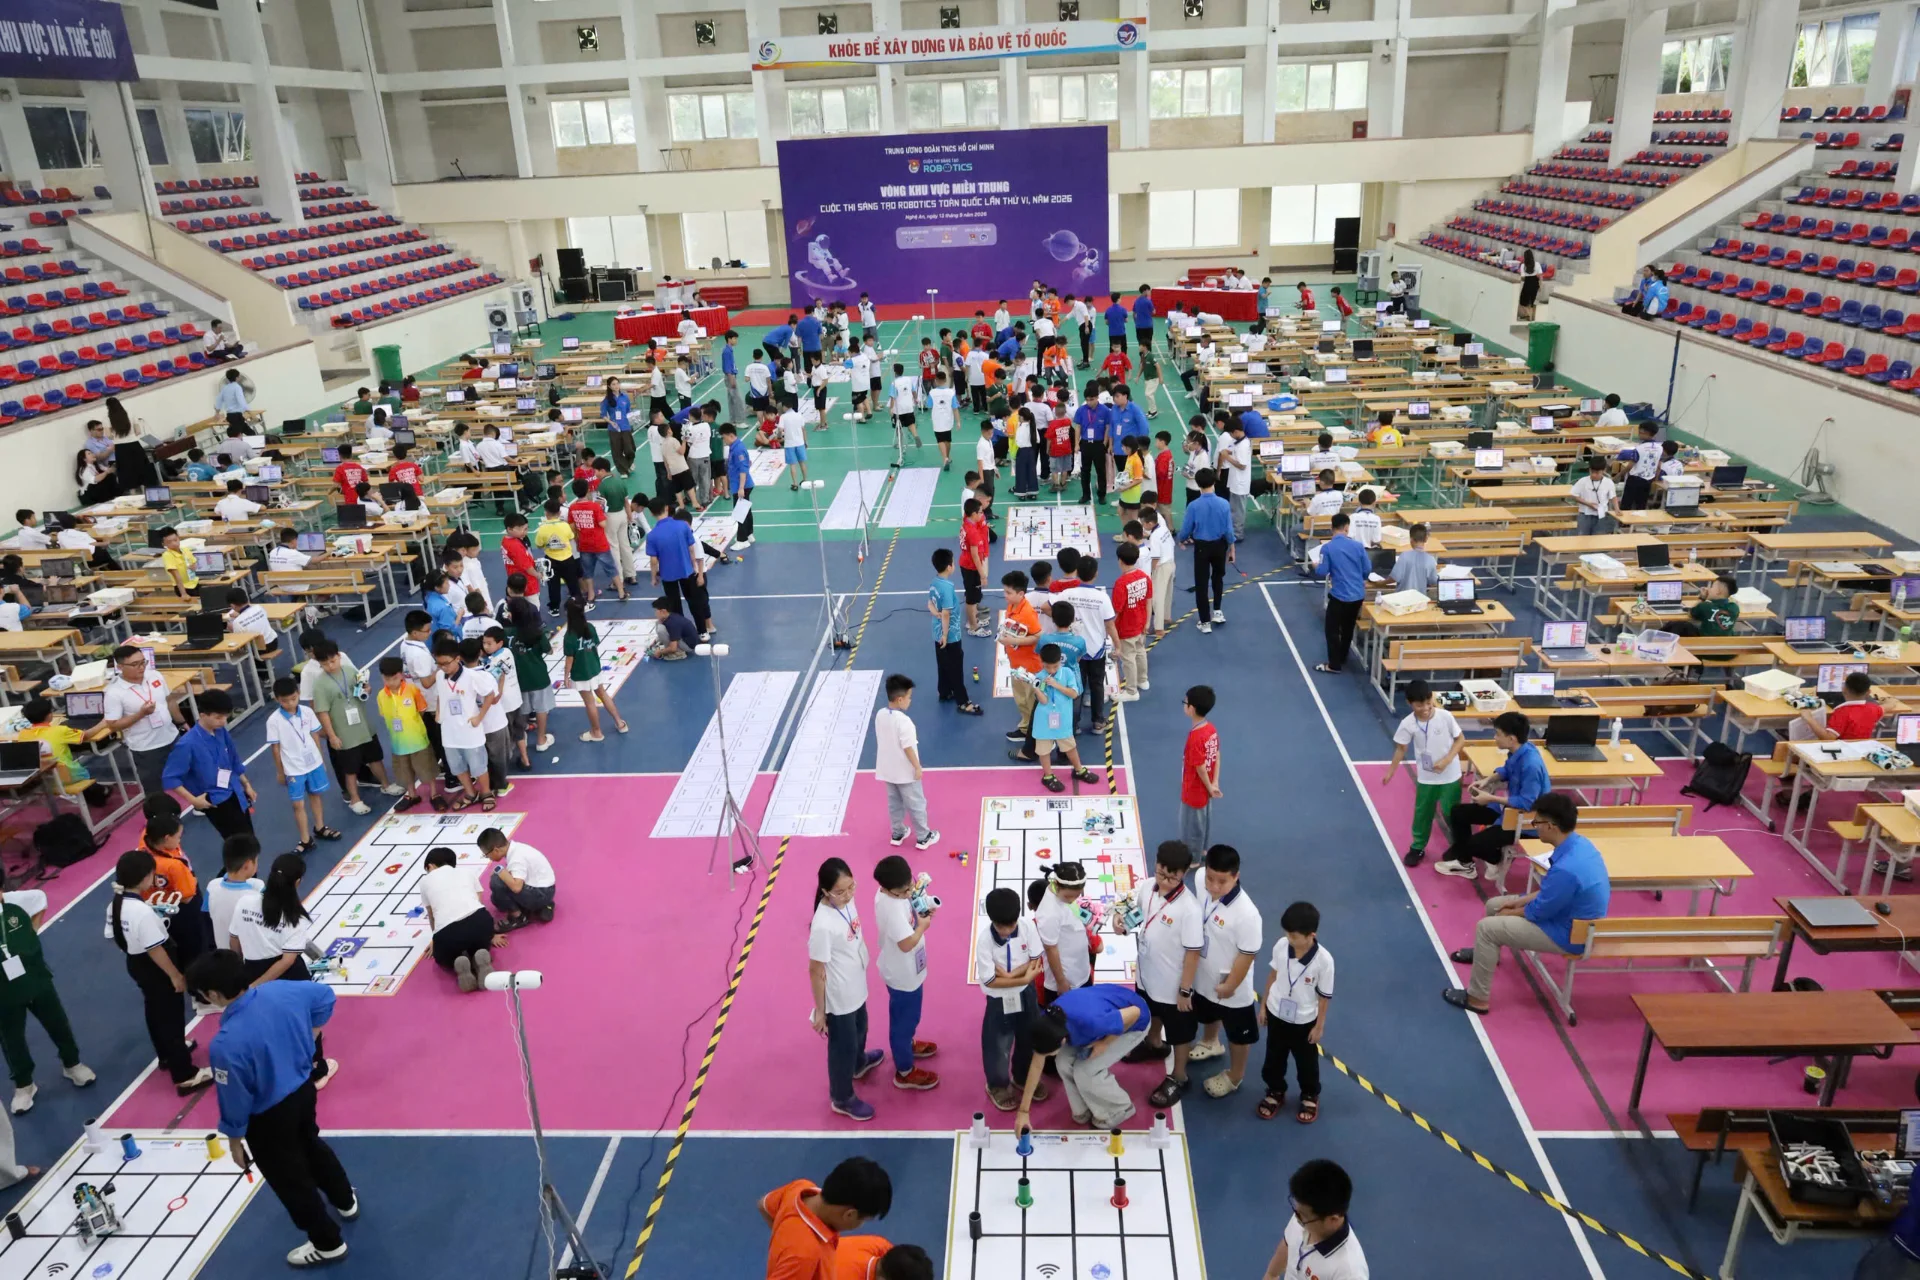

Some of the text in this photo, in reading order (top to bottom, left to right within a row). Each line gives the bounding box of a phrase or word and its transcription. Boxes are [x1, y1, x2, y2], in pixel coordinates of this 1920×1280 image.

[19, 19, 50, 62] VỰC
[46, 18, 69, 56] VÀ
[65, 17, 93, 58] THẾ
[90, 22, 116, 59] GIỚI
[829, 27, 1067, 58] KHỎE ĐỂ XÂY DỰNG VÀ BẢO VỆ TỔ QUỐC
[885, 147, 905, 155] TRUNG
[905, 146, 922, 154] ƯƠNG
[924, 144, 940, 153] ĐOÀN
[958, 142, 967, 152] HỒ
[968, 143, 978, 151] CHÍ
[979, 143, 995, 151] MINH
[923, 163, 973, 173] ROBOTICS
[880, 179, 1010, 197] VÒNG KHU VỰC MIỀN TRUNG
[820, 202, 841, 214] CUỘC
[843, 203, 856, 212] THI
[857, 201, 878, 211] SÁNG
[880, 201, 896, 211] TẠO
[898, 200, 937, 209] ROBOTICS
[938, 197, 959, 208] TOÀN
[961, 196, 982, 208] QUỐC
[984, 195, 1000, 206] LẦN
[1021, 196, 1031, 205] VI,
[1051, 195, 1073, 203] 2026
